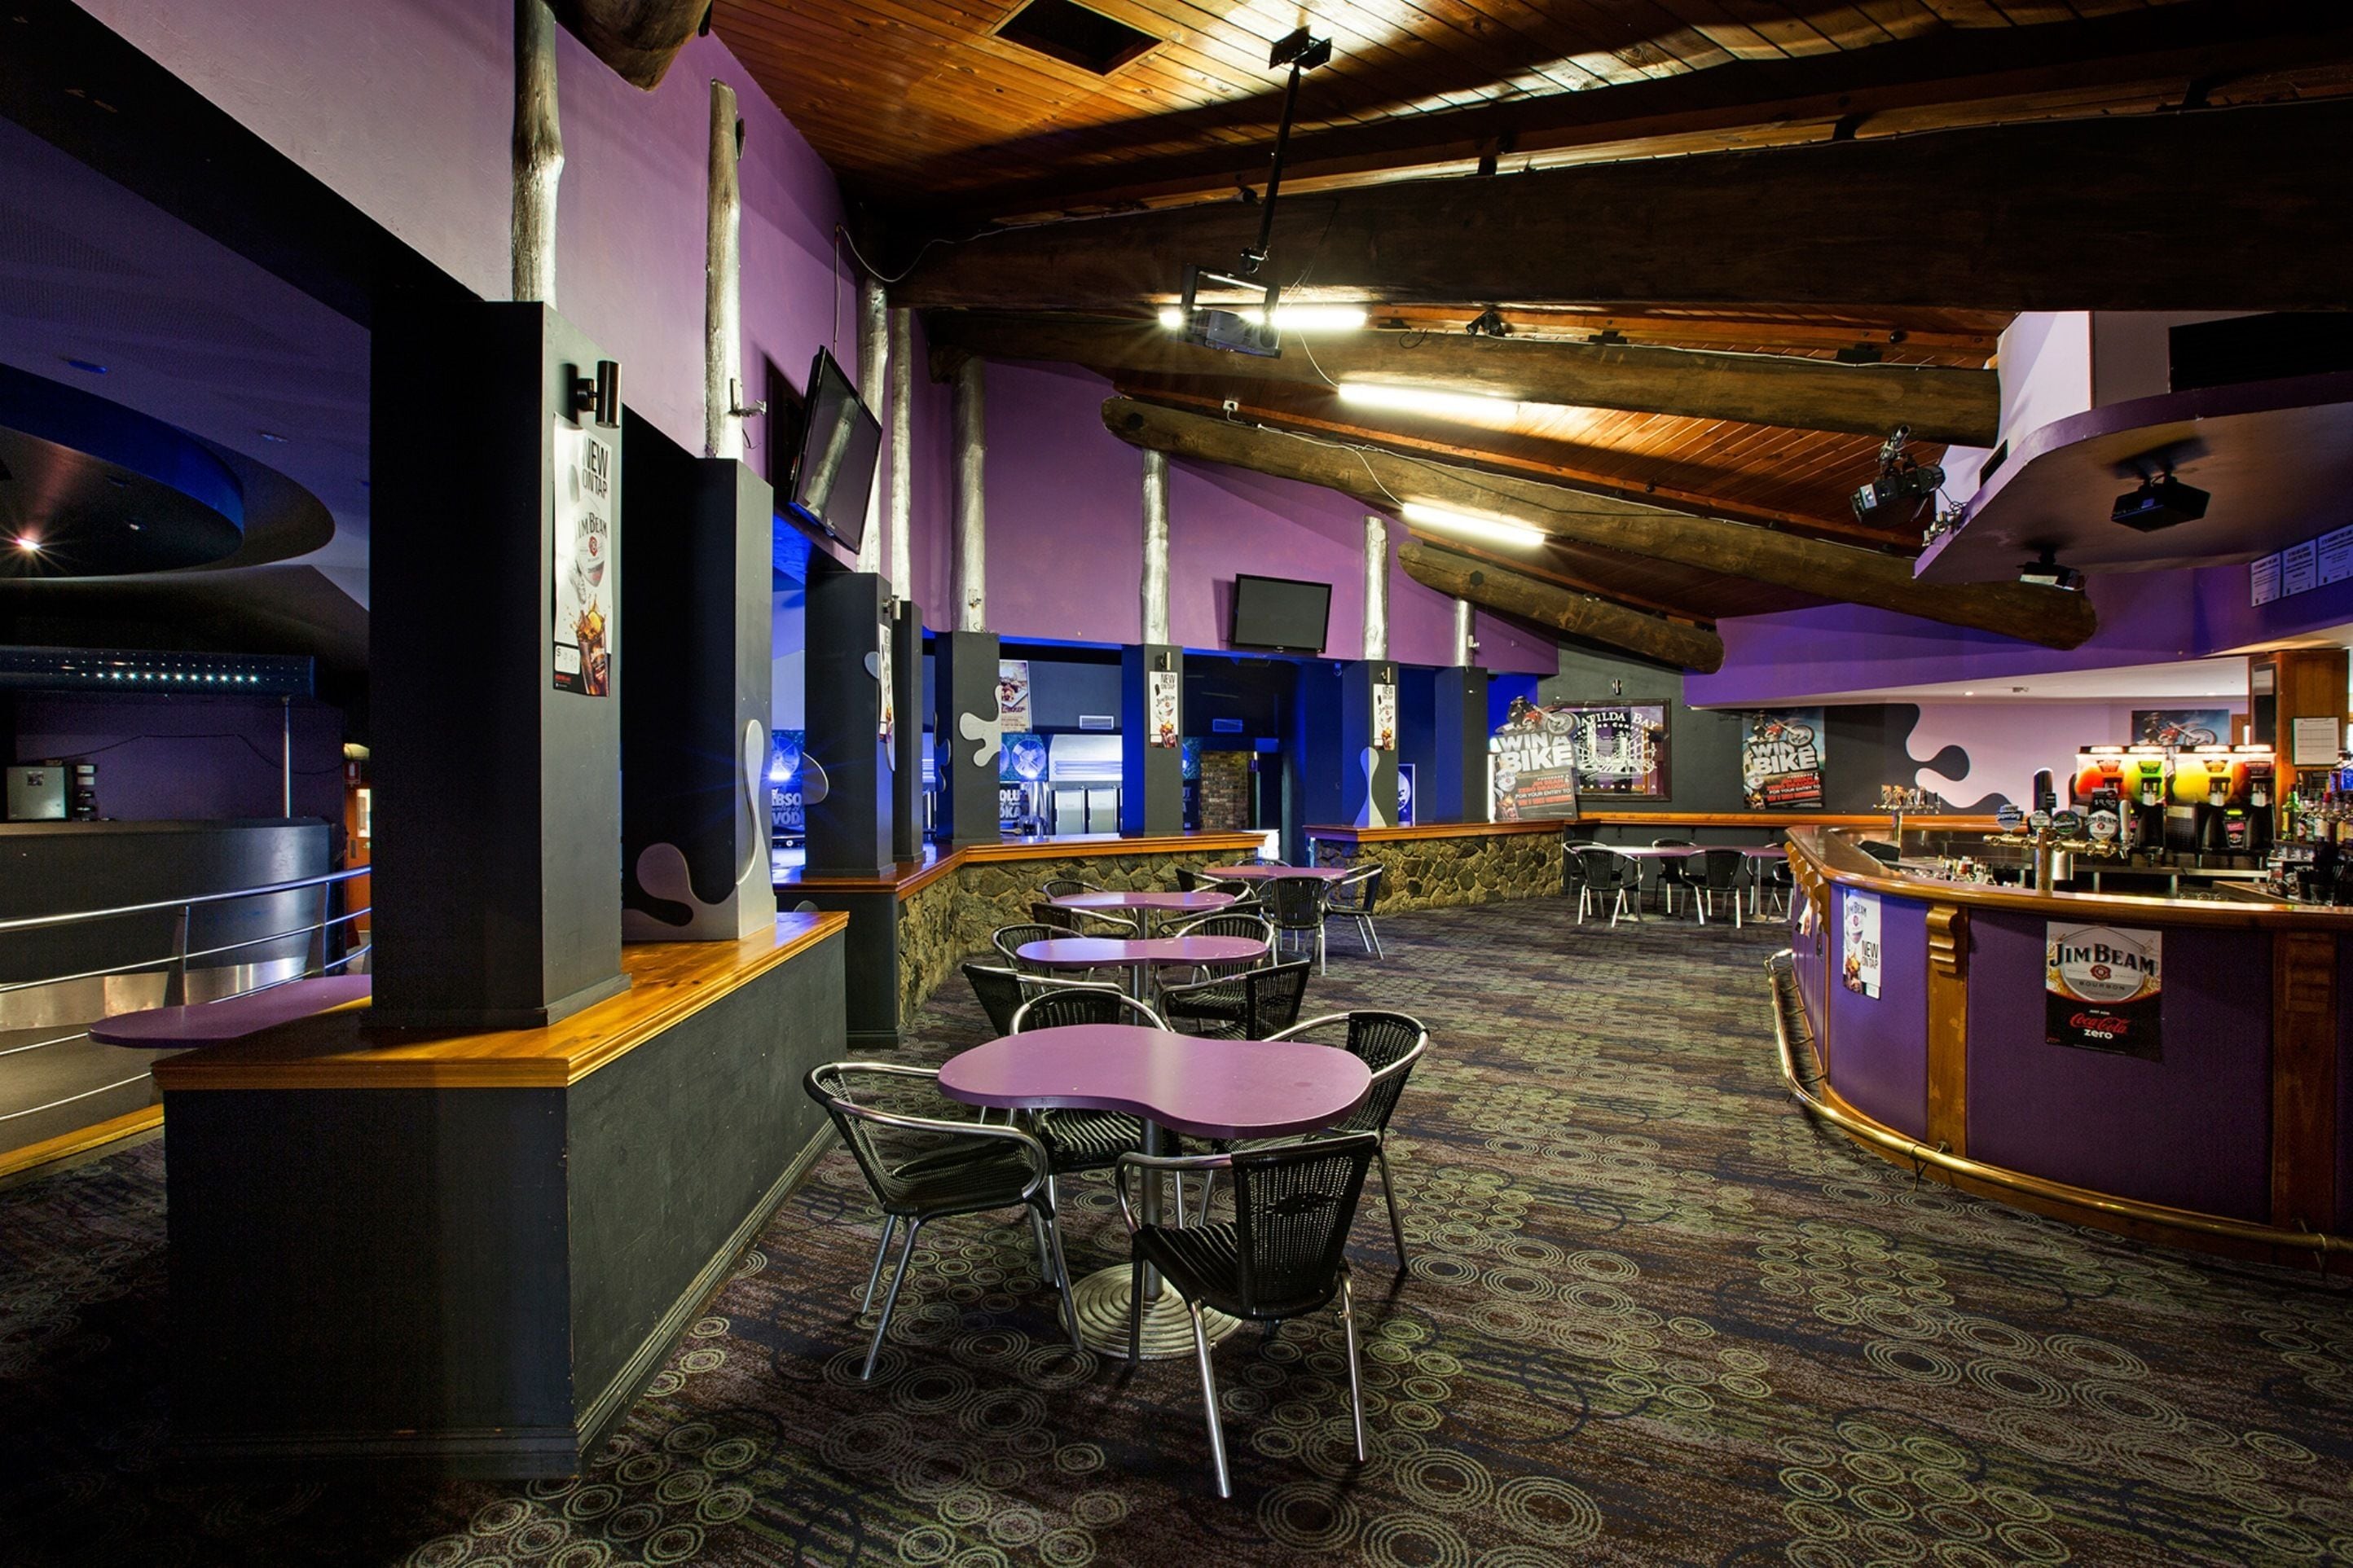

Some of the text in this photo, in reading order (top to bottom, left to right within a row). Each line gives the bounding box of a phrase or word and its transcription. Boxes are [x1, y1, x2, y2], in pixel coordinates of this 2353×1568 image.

[583, 435, 609, 479] NEW
[574, 517, 589, 539] IM
[1579, 712, 1657, 730] ATILDA BAY
[1499, 731, 1549, 750] WIN
[1751, 741, 1795, 758] WIN
[1500, 744, 1574, 772] BIKE
[1753, 750, 1818, 775] BIKE
[1862, 940, 1879, 960] NEW
[2049, 943, 2156, 977] JIM BEAM
[2079, 981, 2125, 990] BOURBON
[2084, 1029, 2113, 1039] zero
